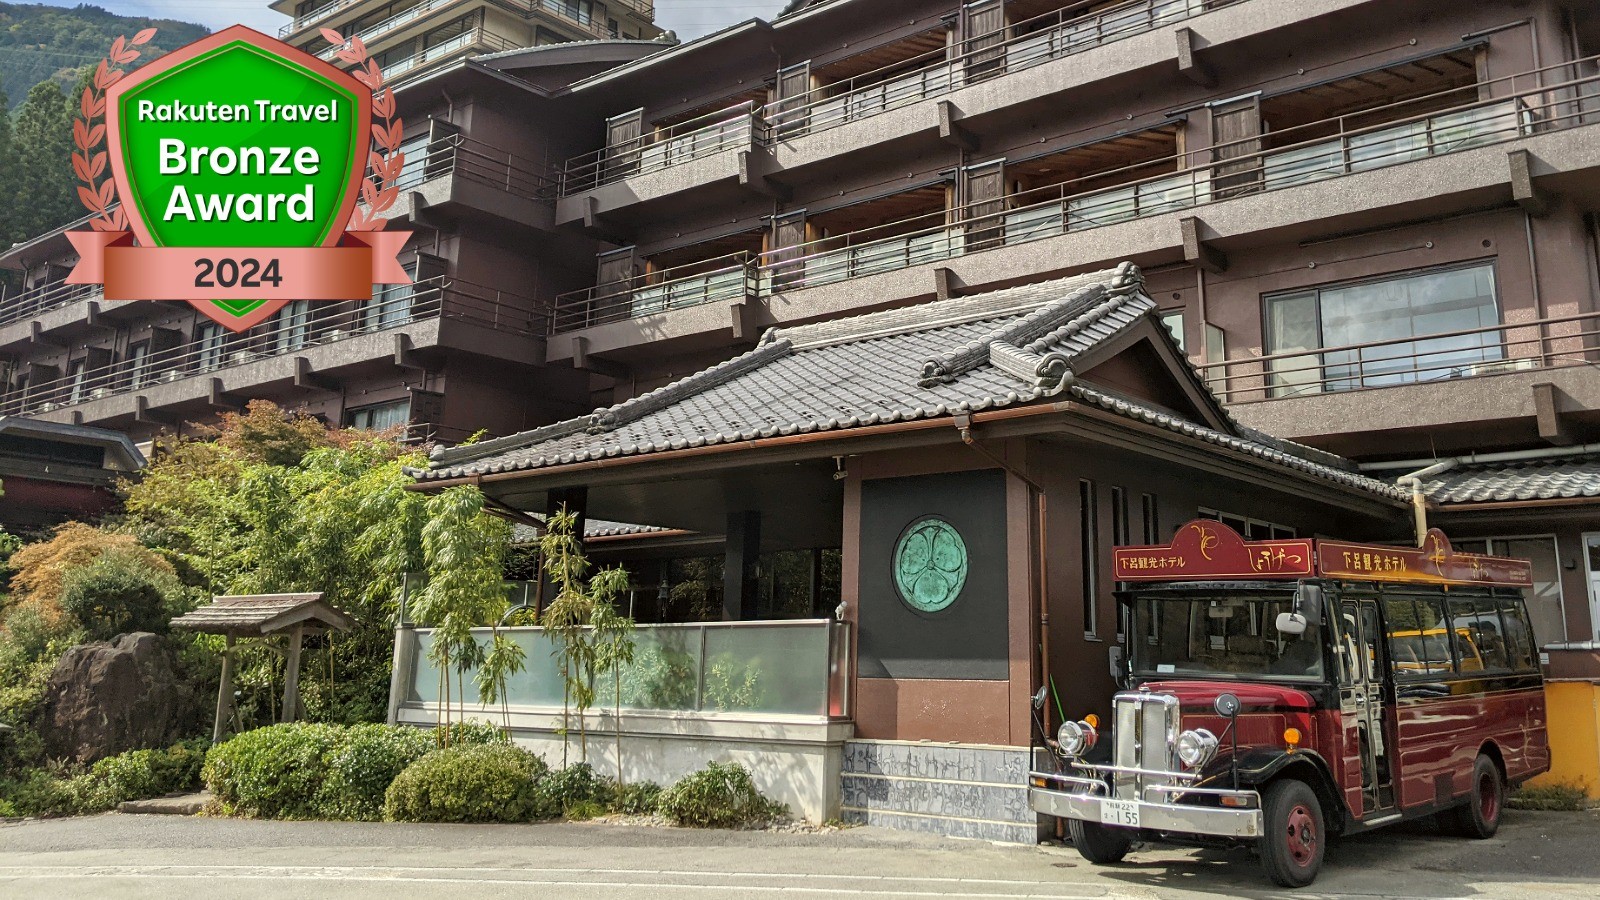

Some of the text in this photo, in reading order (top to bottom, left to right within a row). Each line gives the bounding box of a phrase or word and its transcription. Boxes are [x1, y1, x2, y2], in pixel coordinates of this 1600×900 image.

[1119, 556, 1186, 570] 下呂観光ホテル
[1342, 551, 1407, 572] 下呂観光ホテル
